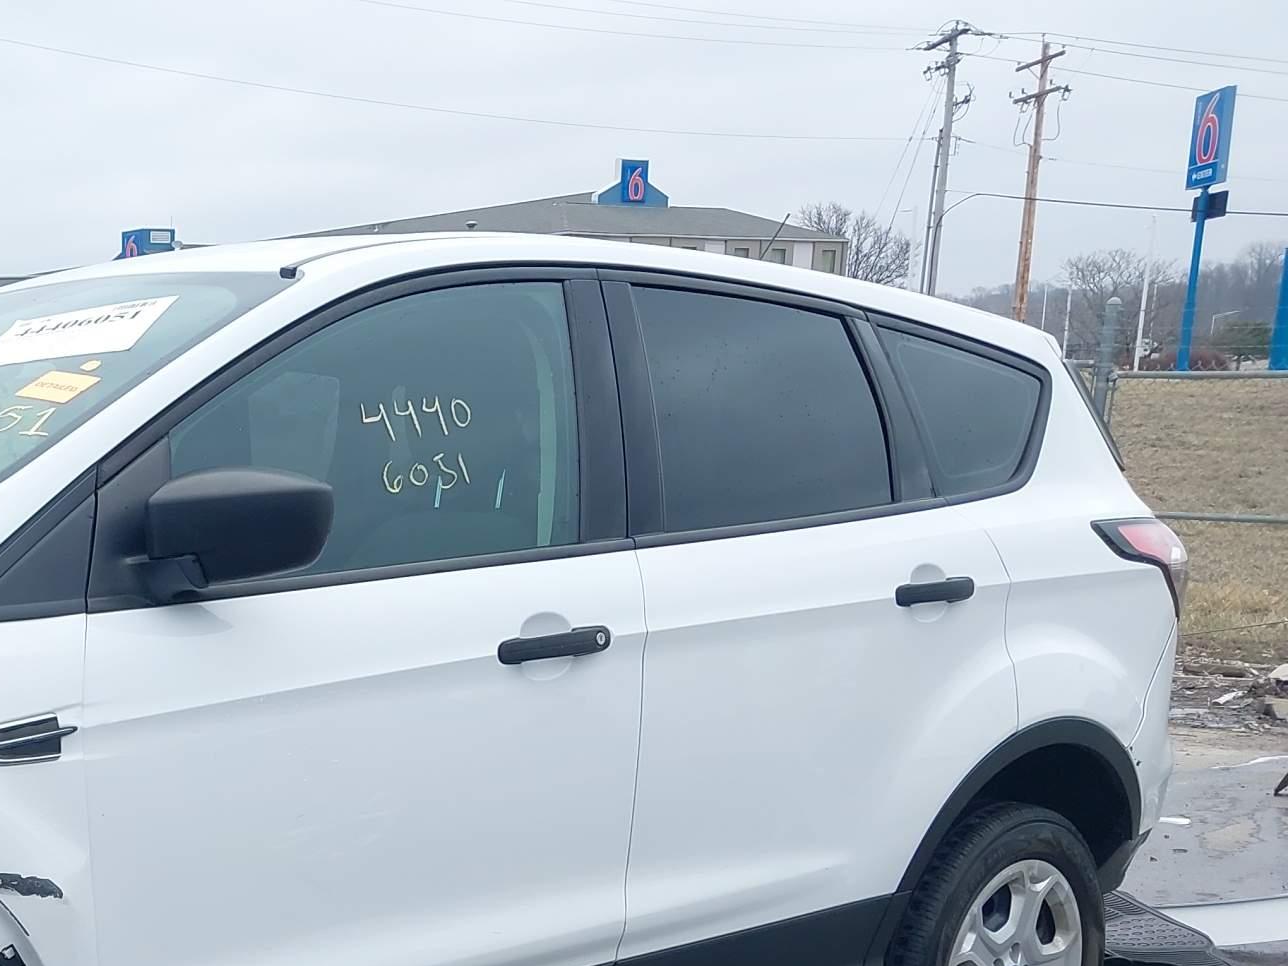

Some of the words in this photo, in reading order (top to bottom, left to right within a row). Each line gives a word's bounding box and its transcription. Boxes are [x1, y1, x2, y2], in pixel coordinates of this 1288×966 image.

[1196, 91, 1220, 166] 6
[628, 166, 645, 201] 6
[360, 395, 472, 442] 4440
[382, 452, 471, 494] 6051
